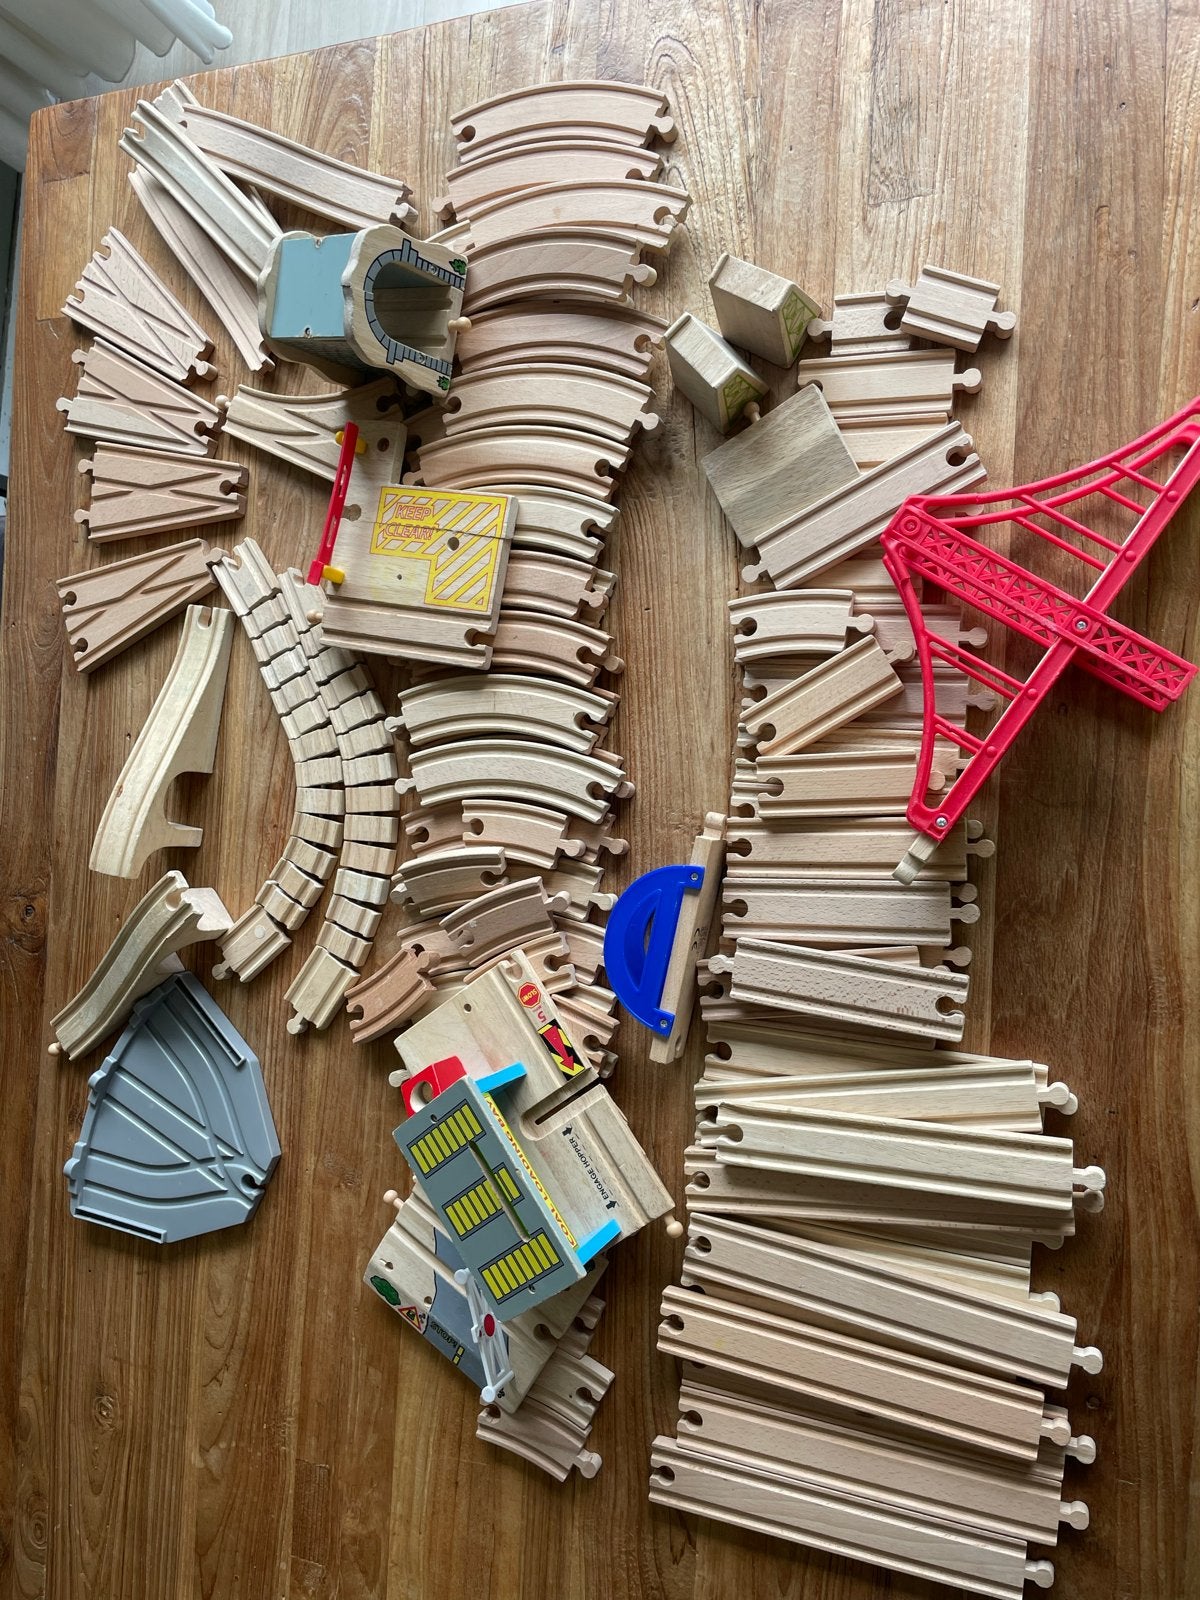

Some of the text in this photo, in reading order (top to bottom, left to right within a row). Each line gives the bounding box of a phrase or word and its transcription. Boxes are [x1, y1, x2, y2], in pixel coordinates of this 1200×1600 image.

[395, 503, 432, 521] KEEP
[385, 523, 434, 540] CLEAR!
[537, 1010, 547, 1023] 5
[487, 1099, 576, 1247] COAL LOADING BAY
[569, 1137, 609, 1200] ENGAGE HOPPER
